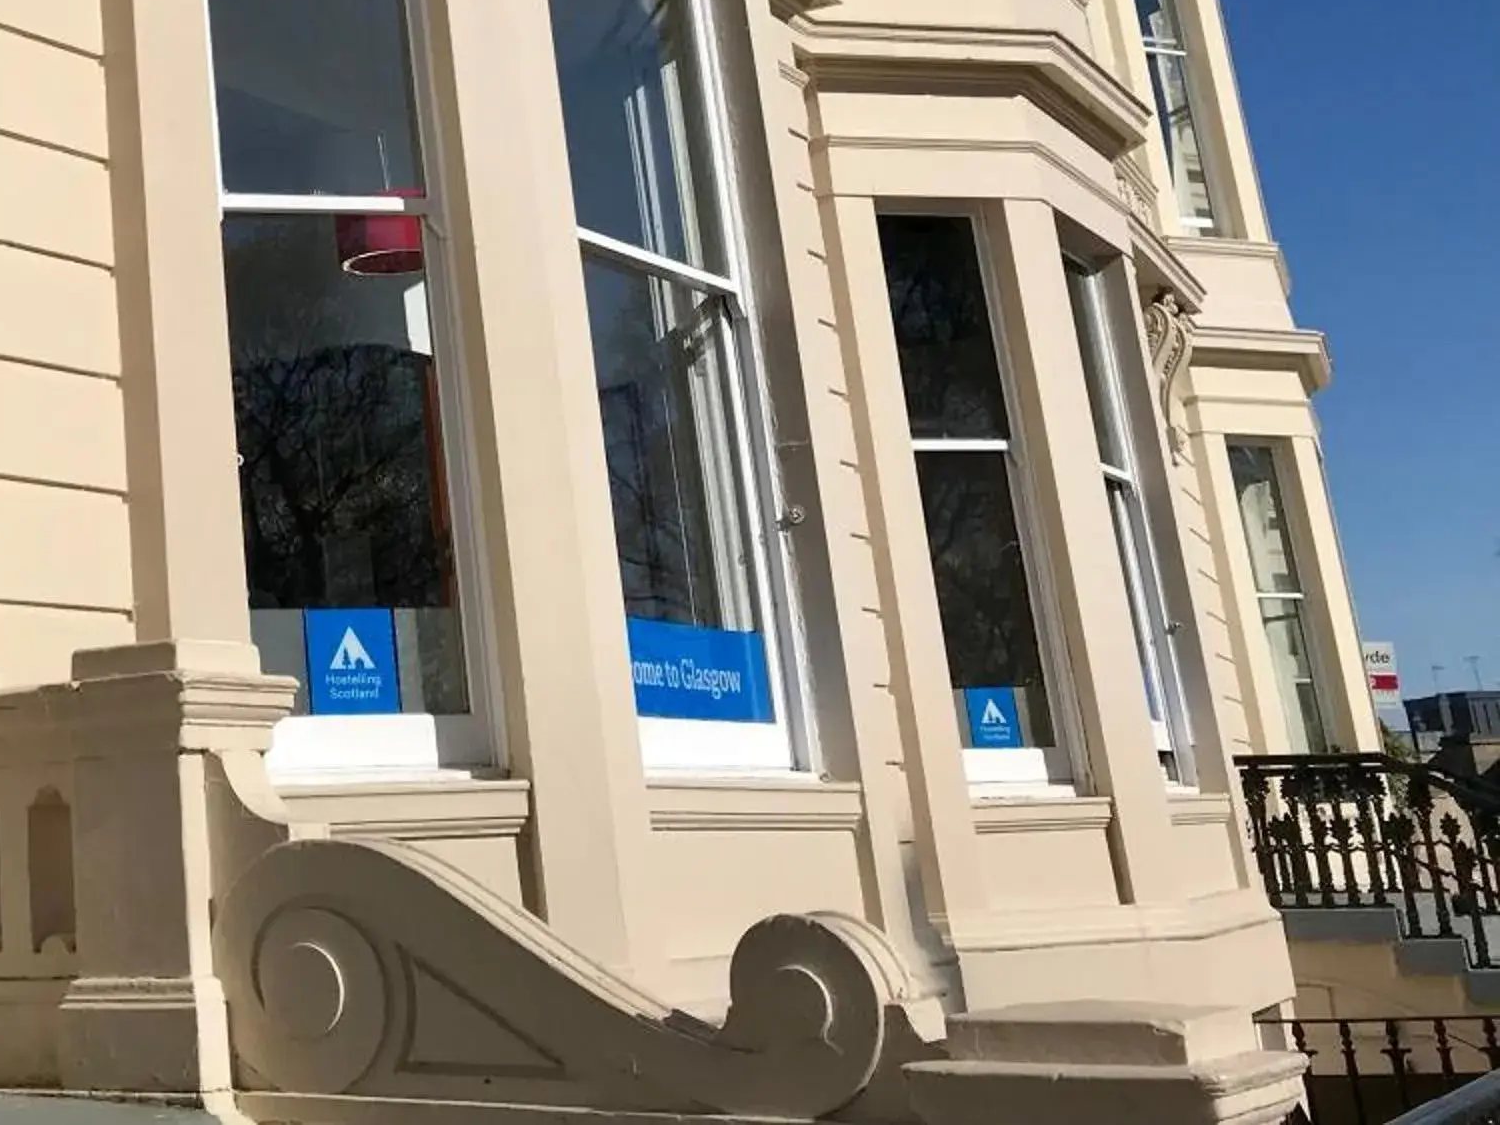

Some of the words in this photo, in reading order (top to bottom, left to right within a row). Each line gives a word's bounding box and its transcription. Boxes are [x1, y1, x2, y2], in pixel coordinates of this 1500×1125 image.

[324, 673, 382, 687] Hostelling
[632, 660, 664, 687] ome
[665, 660, 679, 689] to
[680, 658, 741, 700] Glasgow
[330, 686, 379, 700] Scotland
